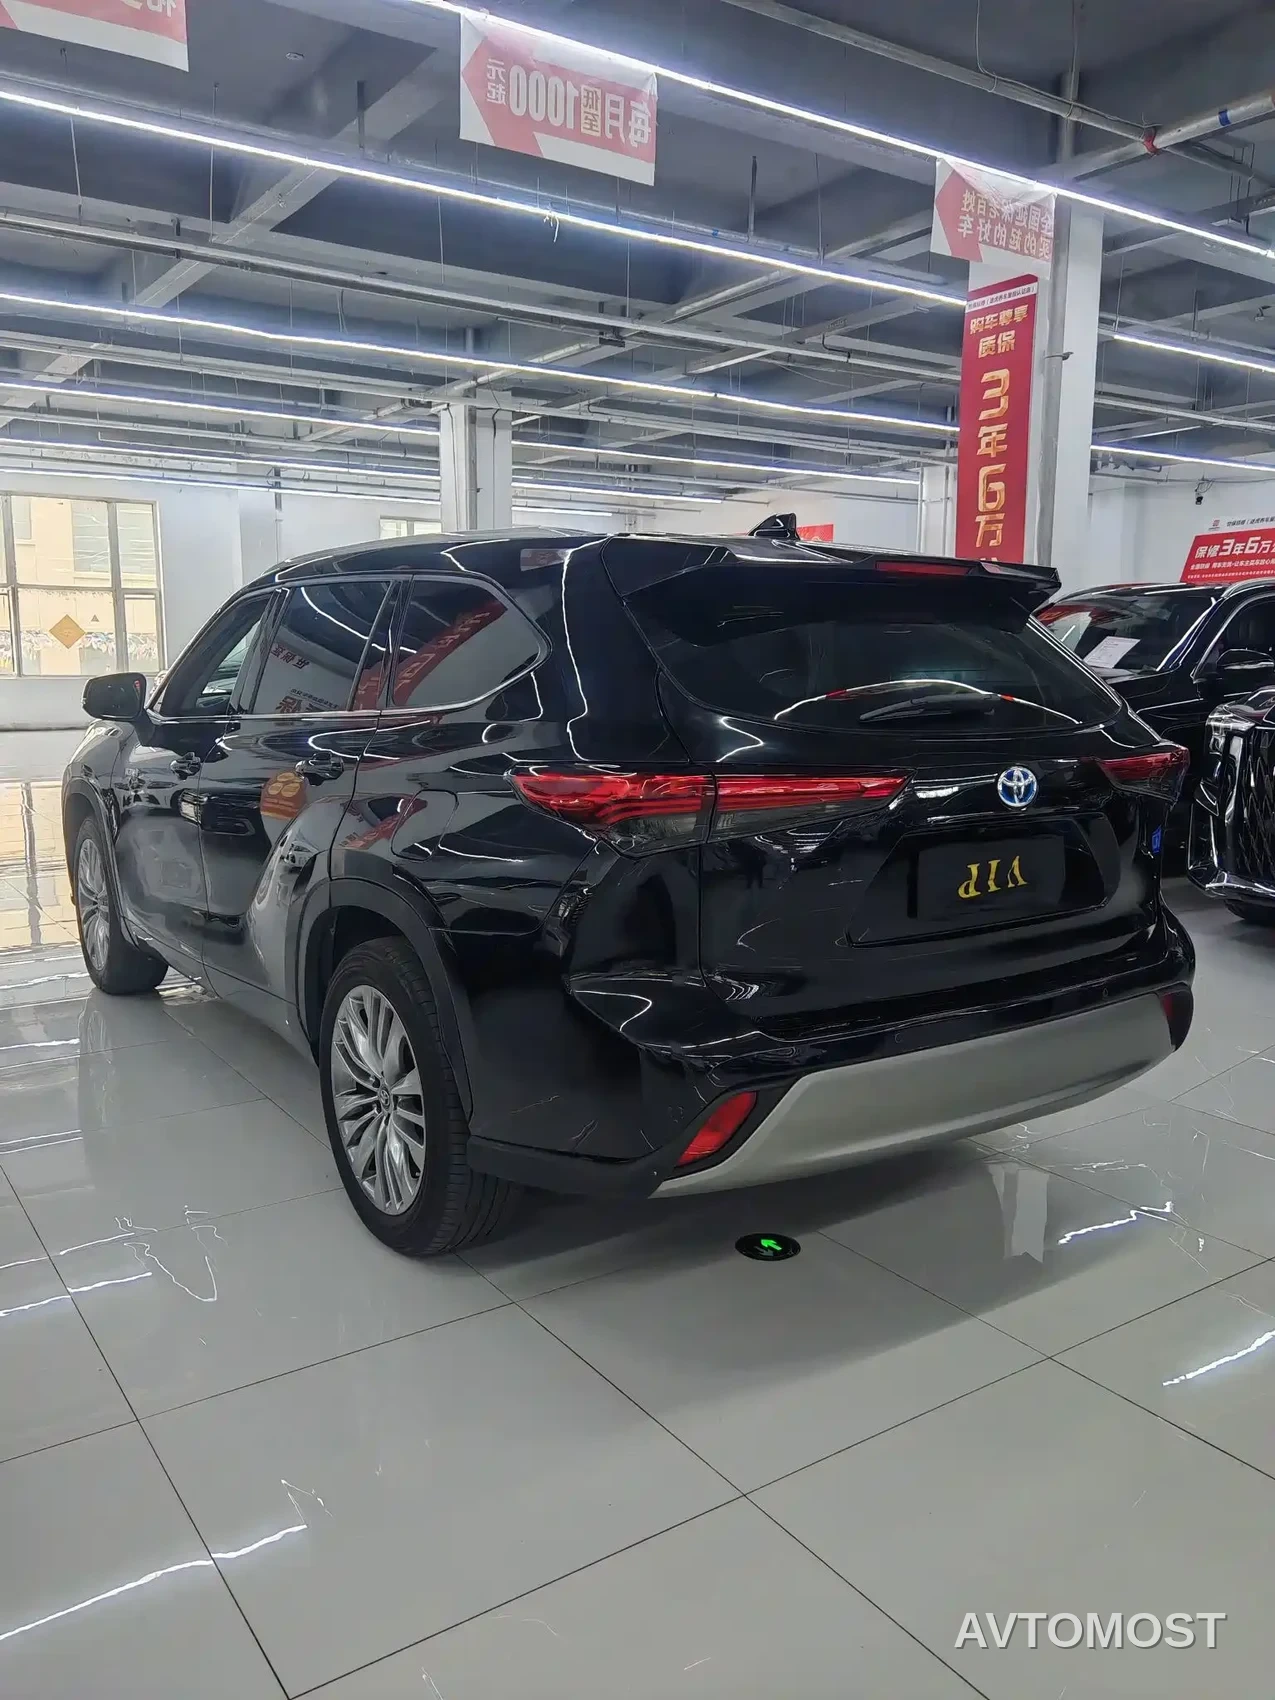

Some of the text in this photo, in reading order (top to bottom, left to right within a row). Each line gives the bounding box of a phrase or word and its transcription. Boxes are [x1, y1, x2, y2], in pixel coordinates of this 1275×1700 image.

[970, 305, 1028, 334] 购车尊享
[978, 330, 1015, 358] 质保
[975, 368, 1010, 561] 3年6万
[958, 855, 1028, 899] VIP
